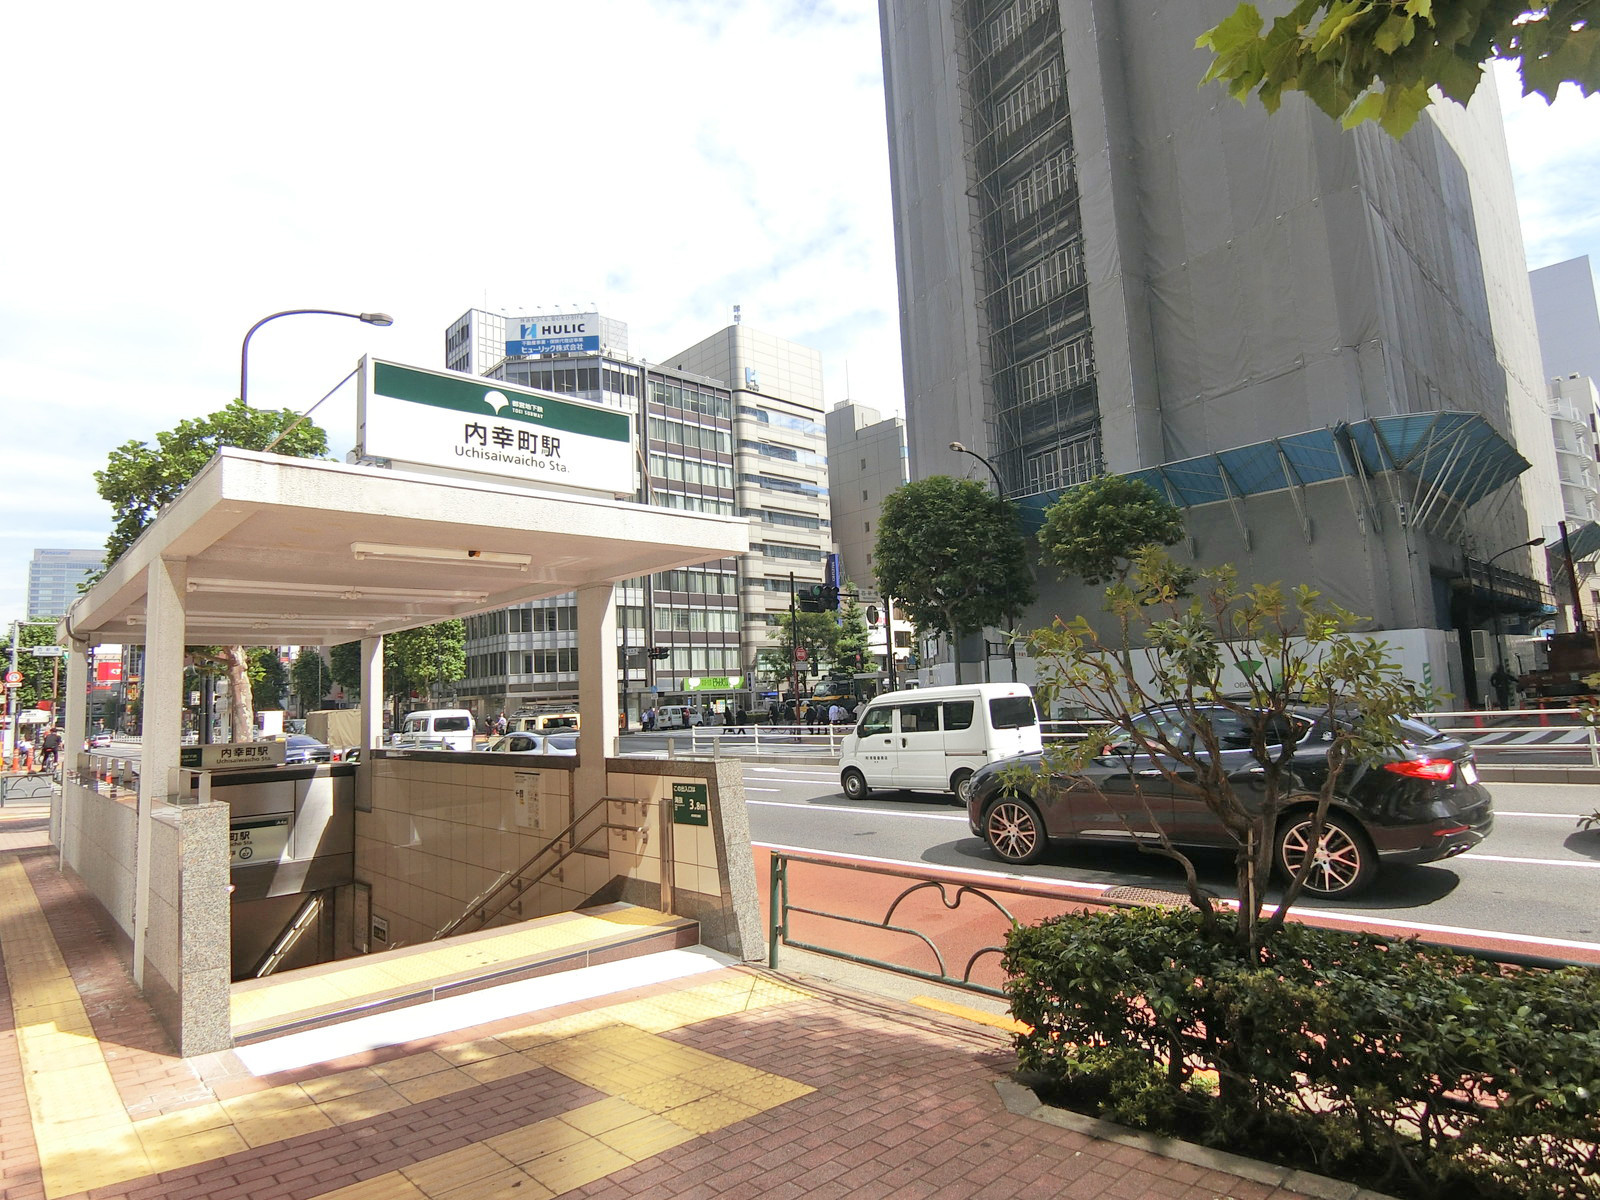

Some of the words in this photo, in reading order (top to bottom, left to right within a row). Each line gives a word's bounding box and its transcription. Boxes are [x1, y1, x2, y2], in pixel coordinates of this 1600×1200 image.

[542, 323, 585, 335] HULIC
[521, 343, 584, 354] ヒューリック株式会社
[511, 400, 544, 413] 都営地下鉄
[464, 422, 561, 458] 内幸町駅
[455, 445, 546, 469] Uchisaiwaicho
[549, 460, 570, 473] Sta.
[221, 746, 269, 758] 内幸町駅
[216, 756, 260, 764] Uchisaiwaicho
[689, 799, 706, 810] 3.8m
[230, 831, 250, 841] 町駅
